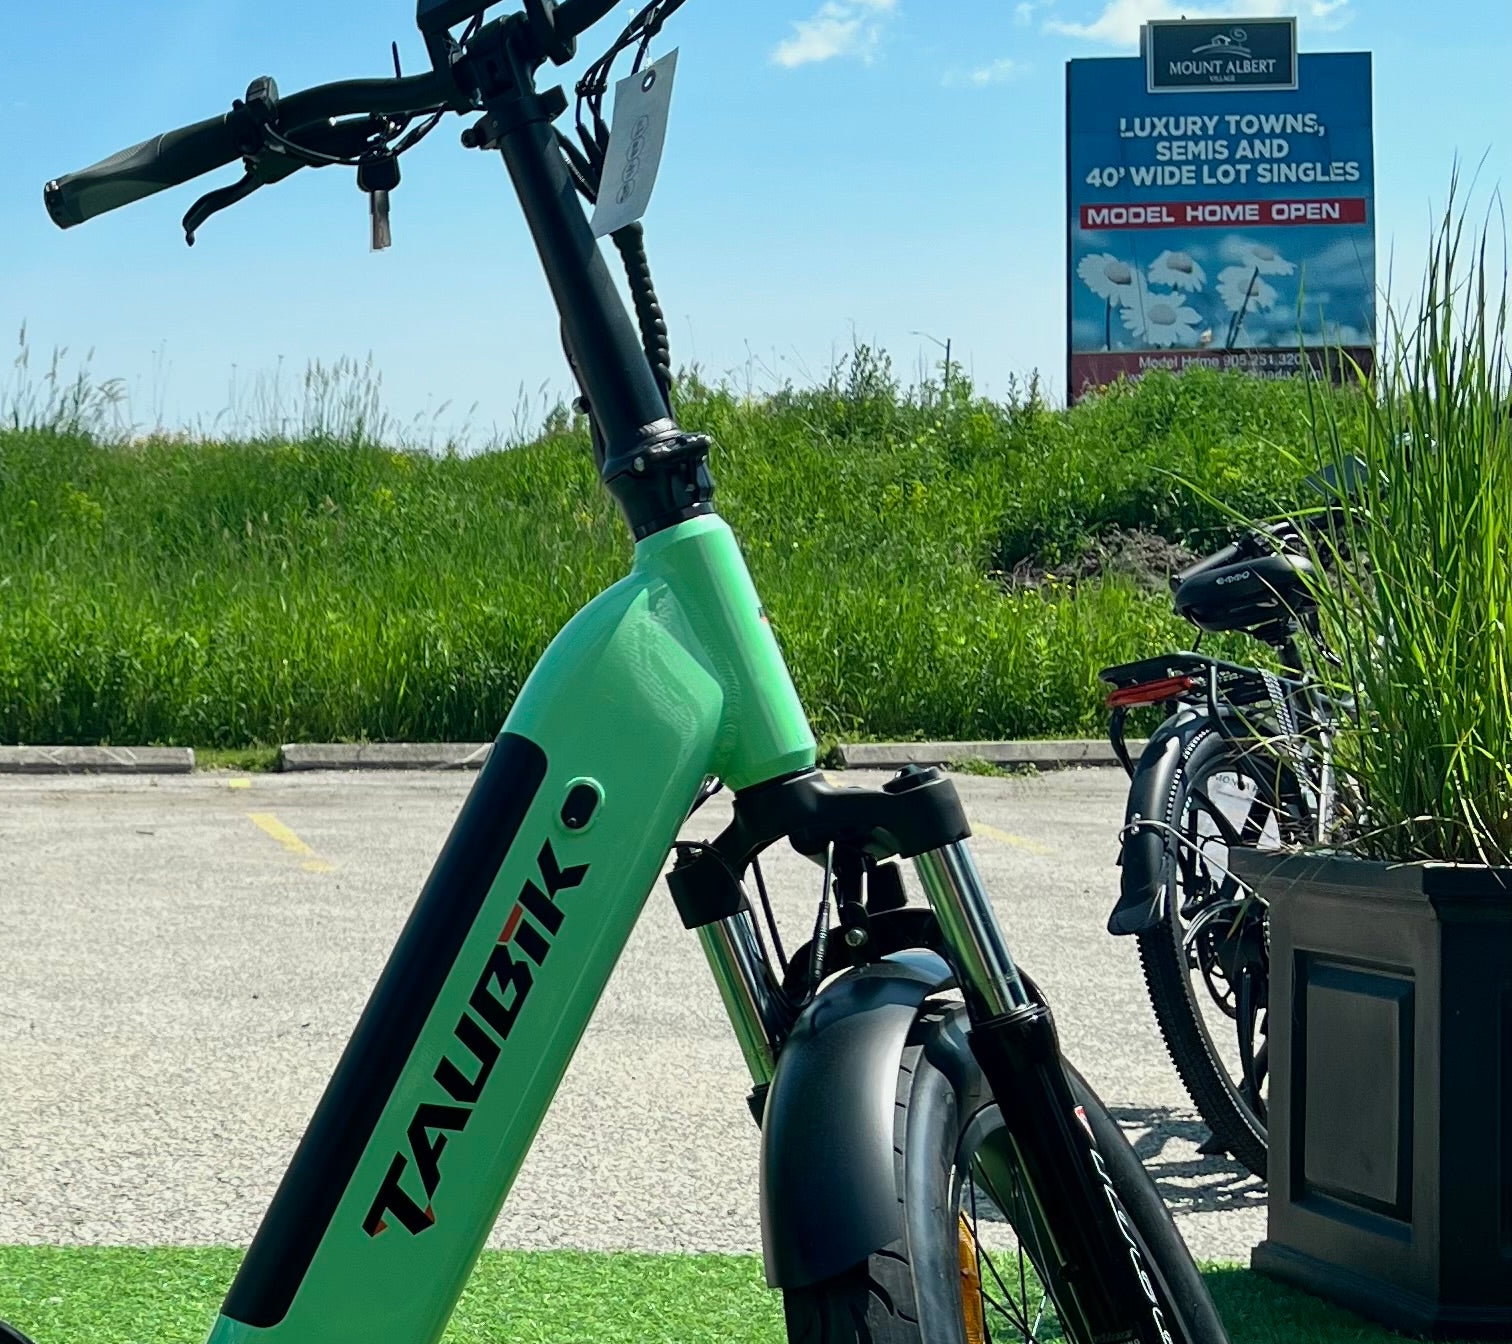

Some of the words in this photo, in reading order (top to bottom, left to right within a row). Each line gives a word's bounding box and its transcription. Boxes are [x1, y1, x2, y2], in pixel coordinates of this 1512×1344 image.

[1169, 60, 1223, 75] MOUNT
[1226, 59, 1276, 73] ALBERT
[1120, 115, 1219, 138] LUXURY
[1225, 113, 1325, 136] TOWNS,
[1156, 140, 1229, 161] SEMIS
[1235, 139, 1289, 159] AND
[1130, 165, 1196, 186] WIDE
[1202, 164, 1251, 184] LOT
[1256, 162, 1360, 183] SINGLES
[1088, 207, 1175, 225] MODEL
[1186, 204, 1260, 222] HOME
[1271, 202, 1340, 220] OPEN
[362, 837, 590, 1238] TAUBIK
